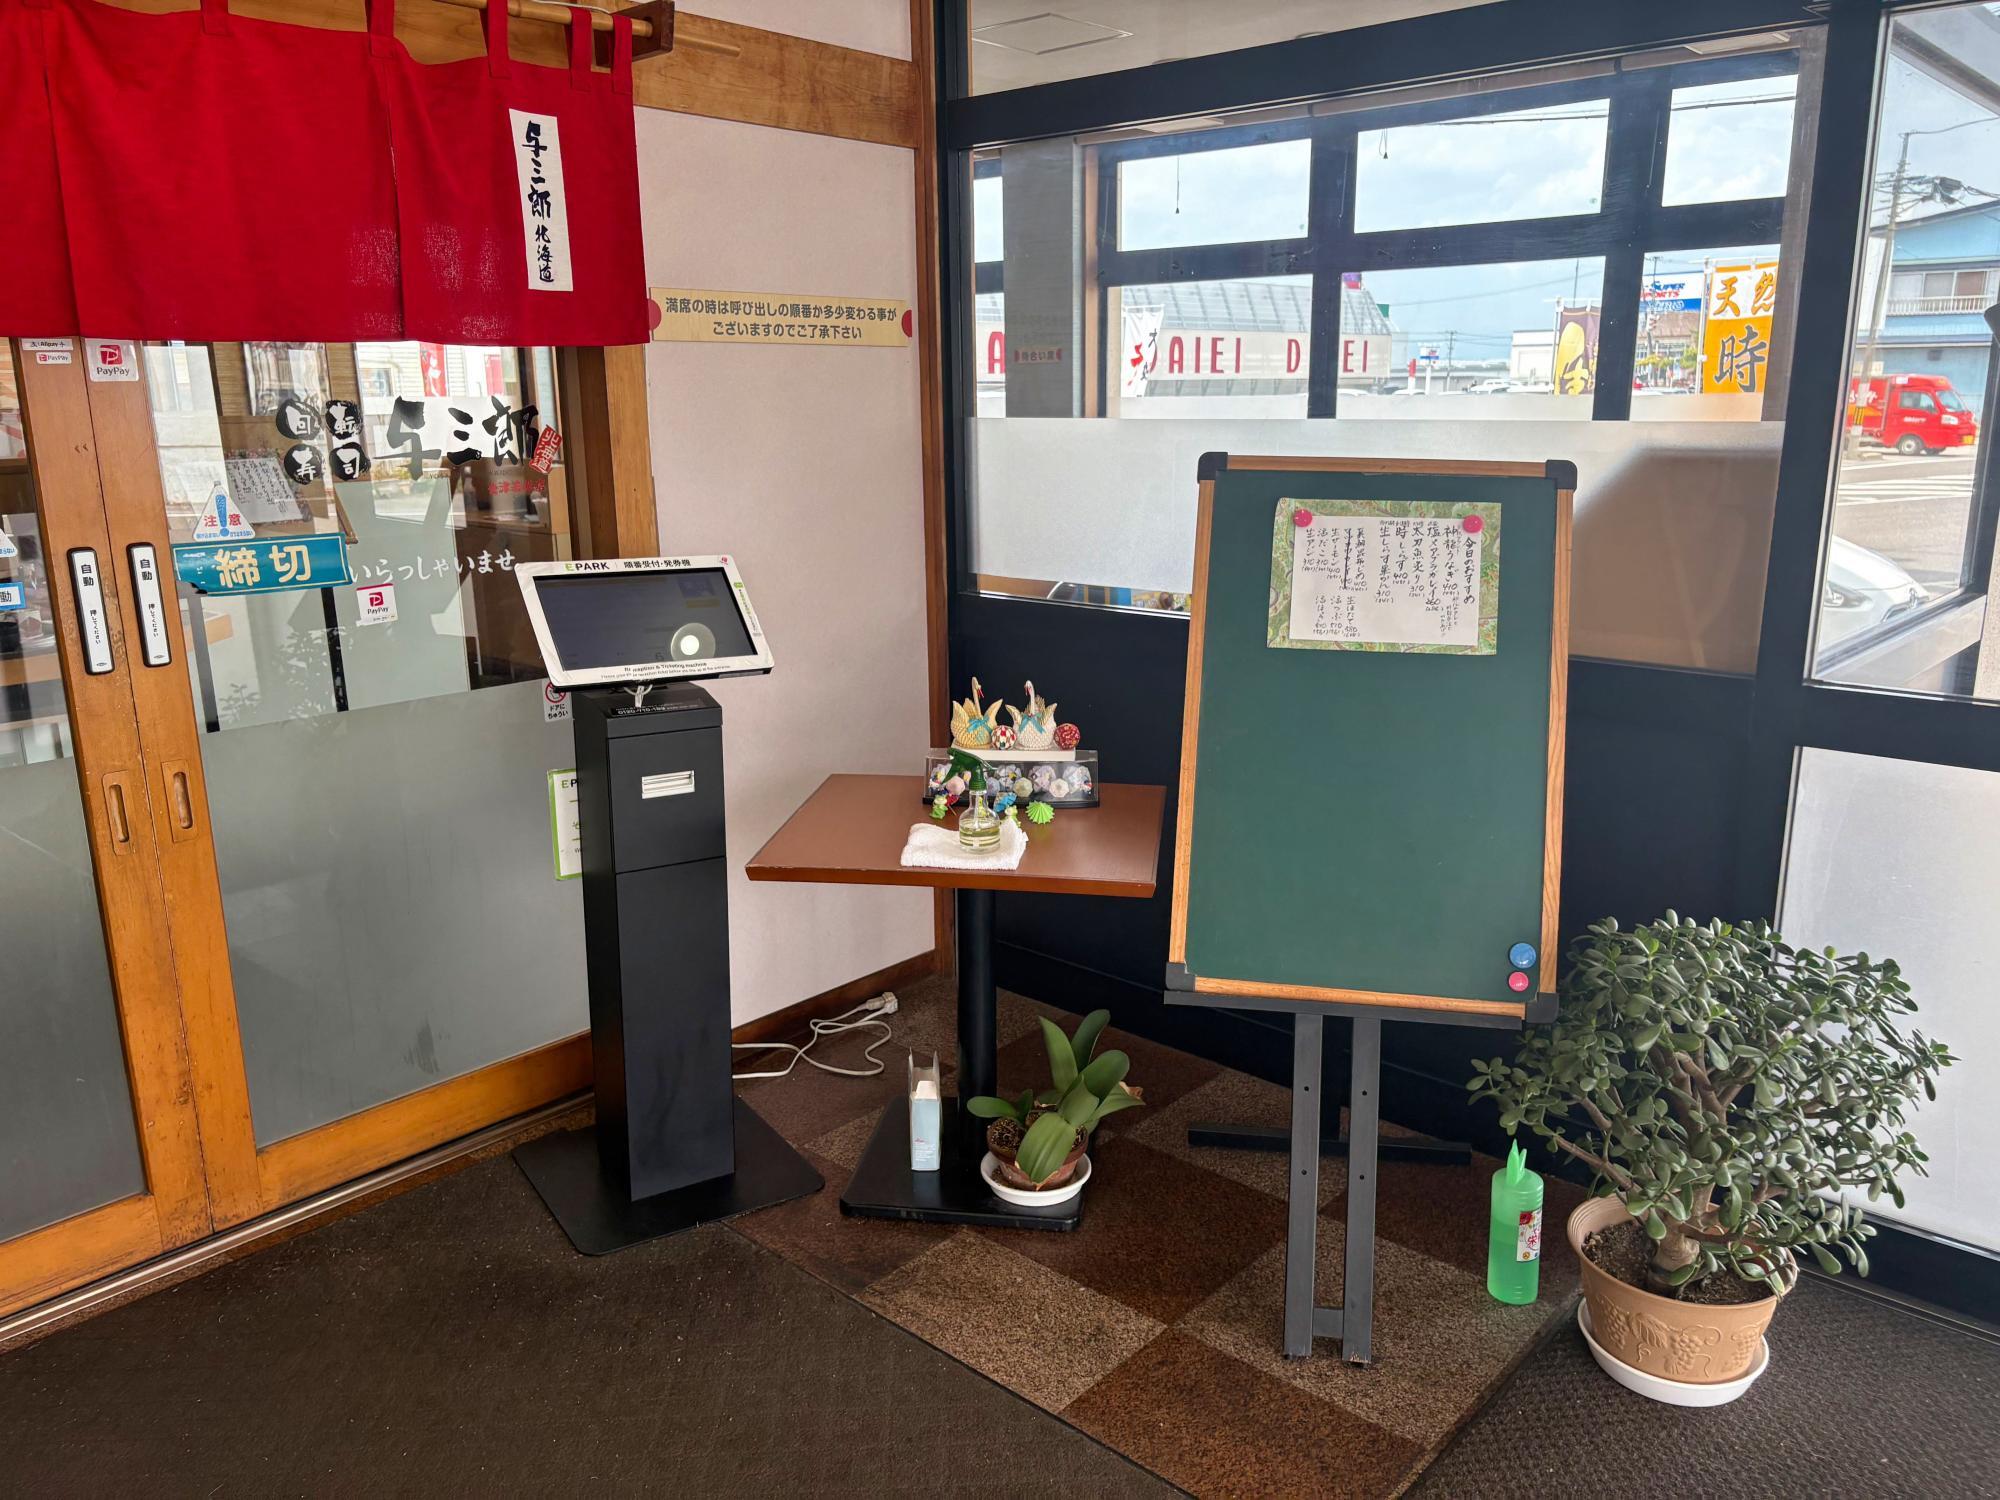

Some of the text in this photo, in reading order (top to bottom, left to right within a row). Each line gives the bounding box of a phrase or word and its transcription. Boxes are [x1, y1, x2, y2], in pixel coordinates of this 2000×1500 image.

[522, 120, 554, 283] 与三郎 北海道
[713, 320, 862, 339] ございますのでご了承下さい
[97, 367, 130, 376] PayPay
[281, 401, 360, 438] 回転
[373, 395, 539, 481] 与三郎
[530, 425, 562, 474] 北海道
[287, 446, 362, 481] 寿司
[204, 513, 242, 527] 注意
[81, 563, 95, 587] 自動
[140, 558, 153, 581] 自動
[215, 545, 312, 588] 締切
[350, 549, 516, 583] いらっしゃいませ
[564, 562, 610, 571] EPARK
[1393, 572, 1408, 580] 410
[1463, 537, 1477, 604] 今日のおすすめ
[368, 607, 389, 615] PayPay
[548, 711, 569, 720] ちゅうい
